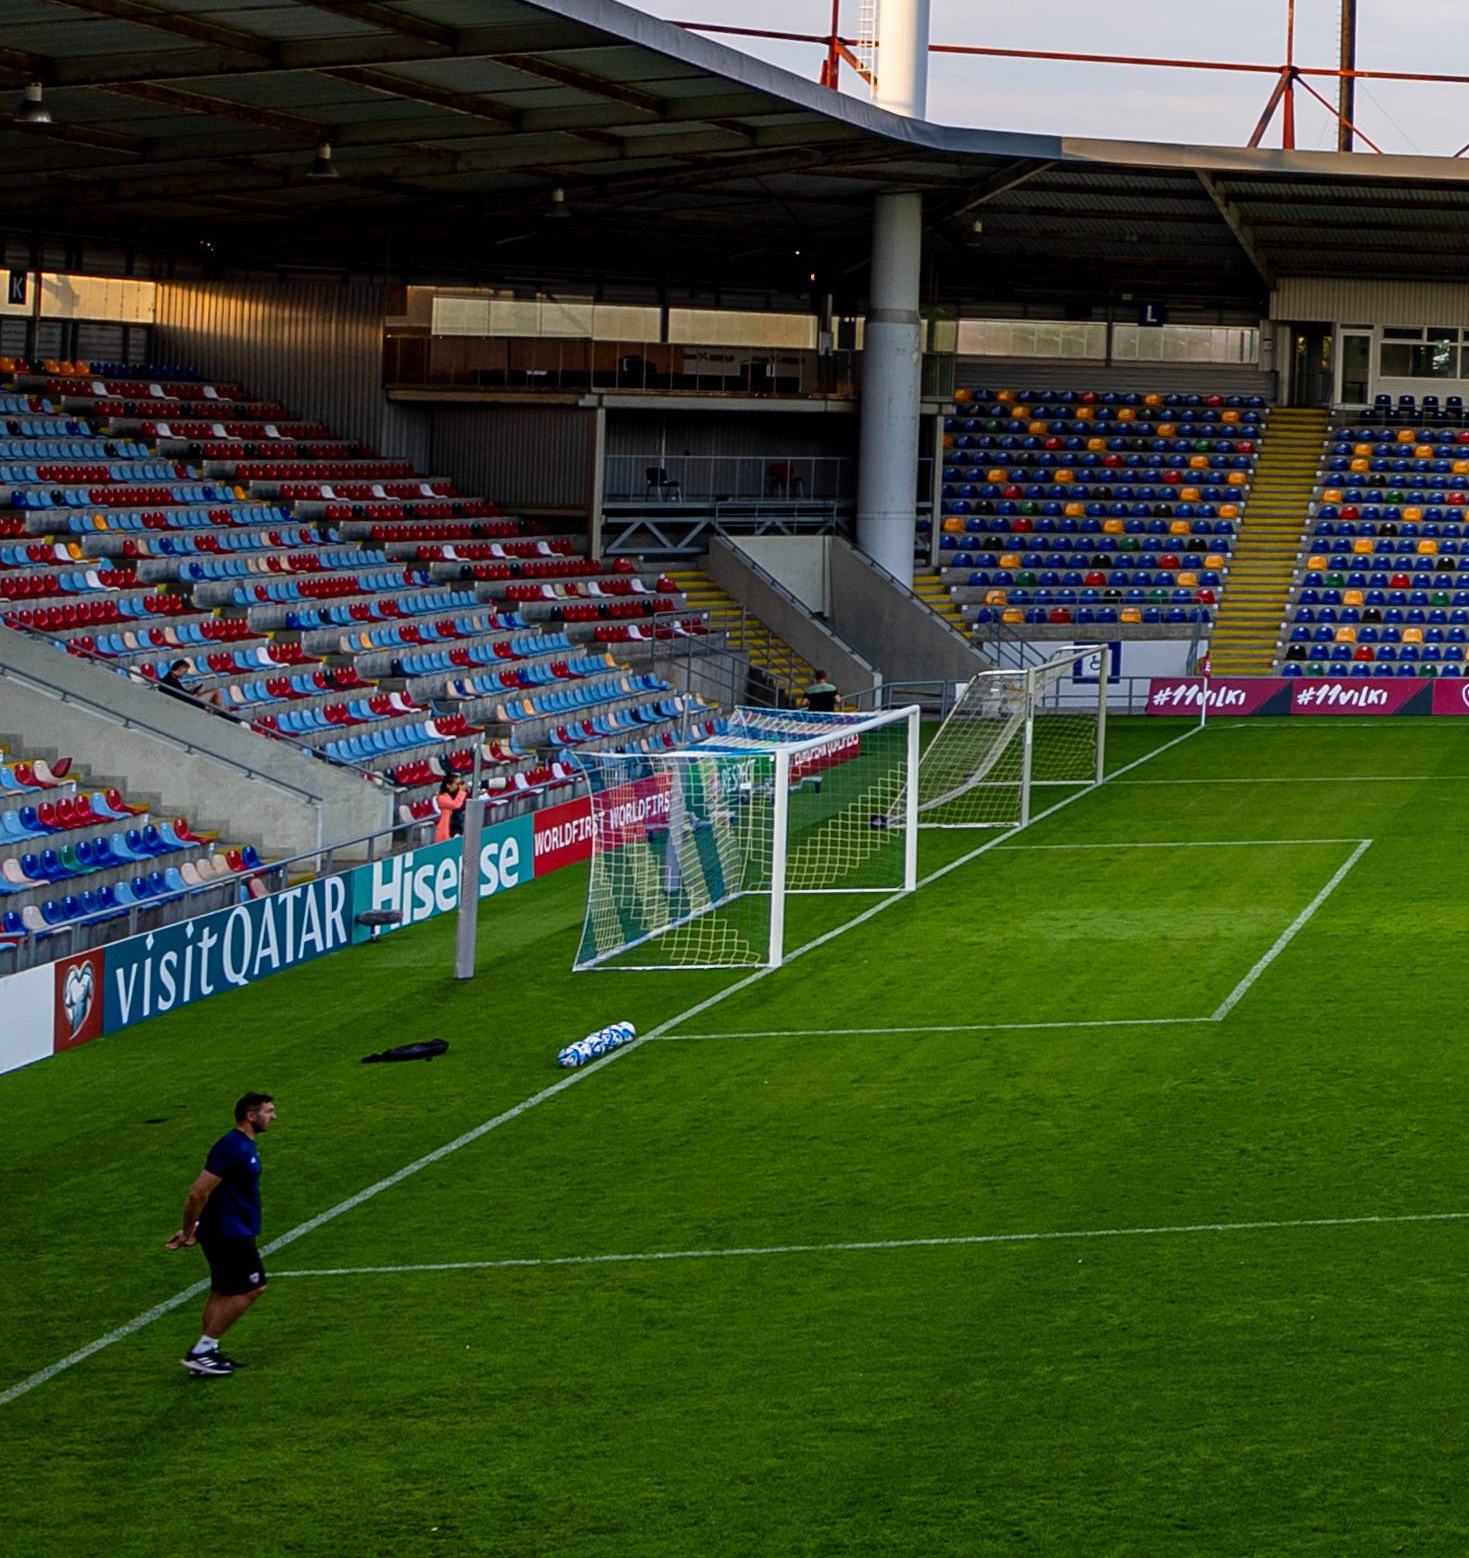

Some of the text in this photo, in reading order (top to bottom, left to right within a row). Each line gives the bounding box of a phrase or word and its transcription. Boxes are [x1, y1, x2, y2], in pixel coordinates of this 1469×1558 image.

[13, 276, 23, 300] K
[1146, 304, 1158, 323] L
[372, 837, 520, 935] Hisese
[115, 876, 348, 1025] visit QATAR
